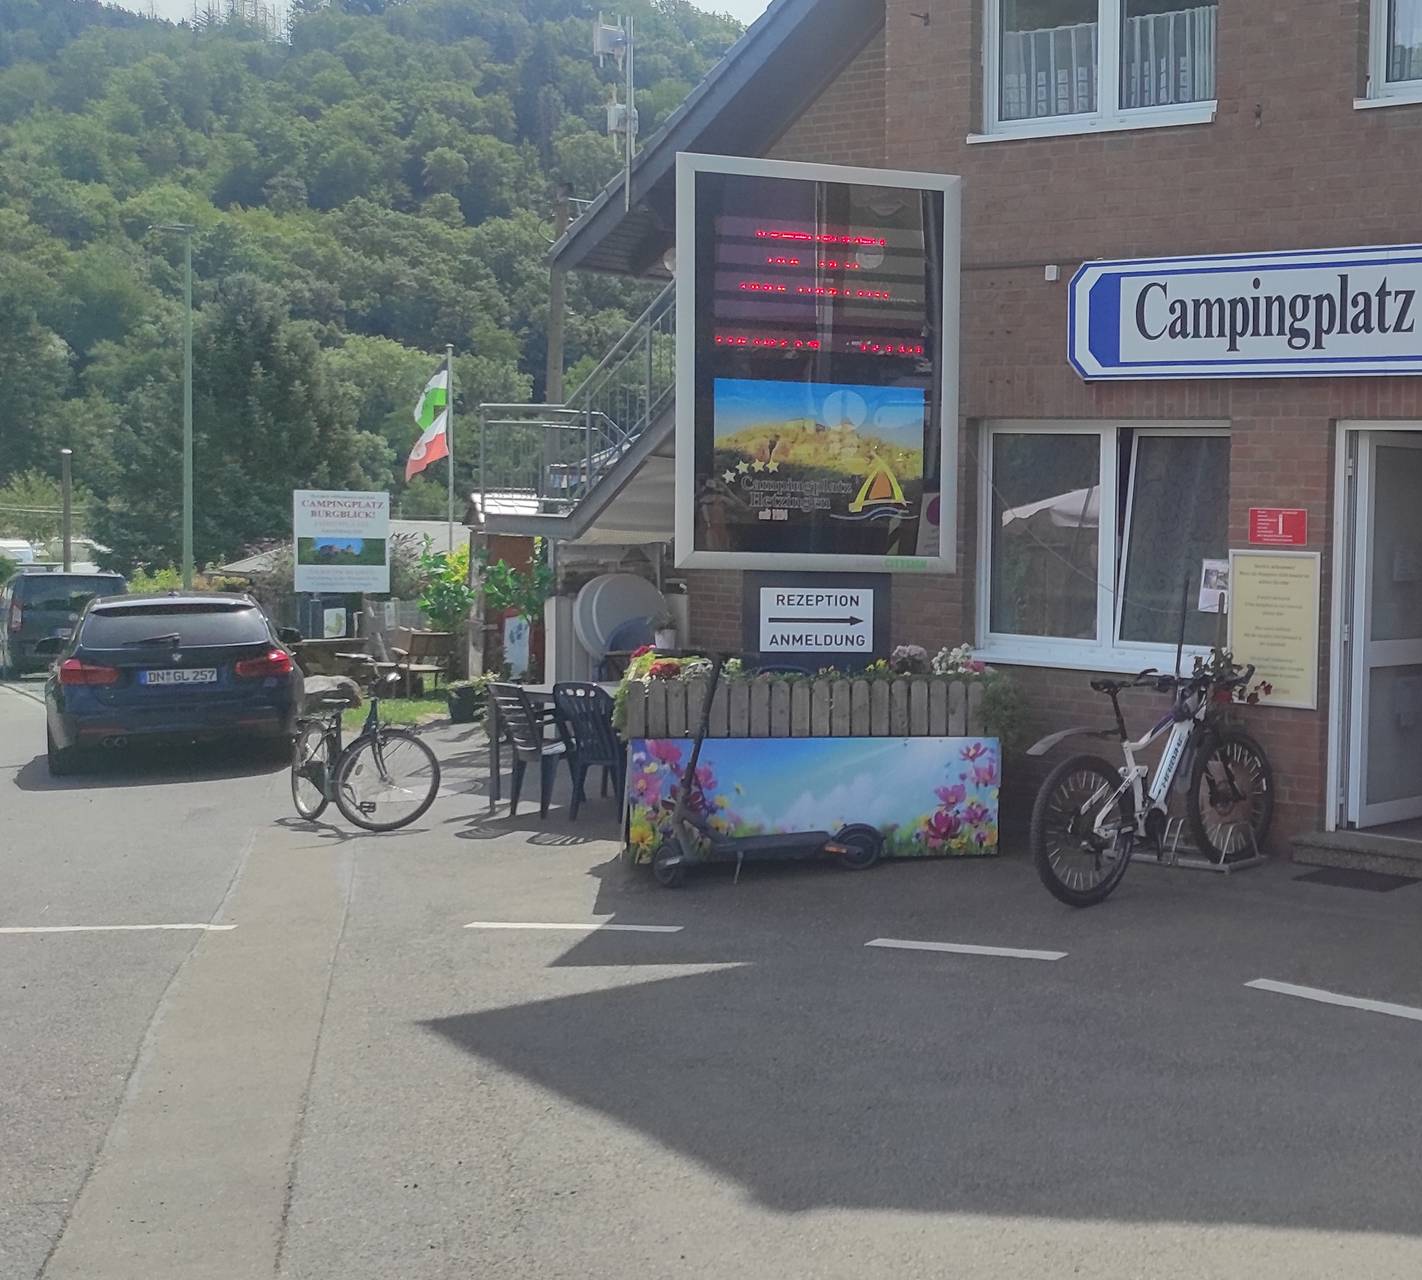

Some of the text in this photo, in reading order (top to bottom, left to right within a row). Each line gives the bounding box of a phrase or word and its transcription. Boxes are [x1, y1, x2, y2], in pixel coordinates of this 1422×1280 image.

[1135, 273, 1415, 352] Campingplatz
[741, 476, 853, 496] Campingplatz
[302, 500, 384, 509] CAMPINGPLATZ
[749, 491, 831, 512] Hetzingen
[311, 510, 376, 519] BURGBLICK!
[776, 594, 860, 607] REZEPTION
[769, 634, 865, 647] ANMELDUNG
[148, 670, 216, 682] DN GL 257
